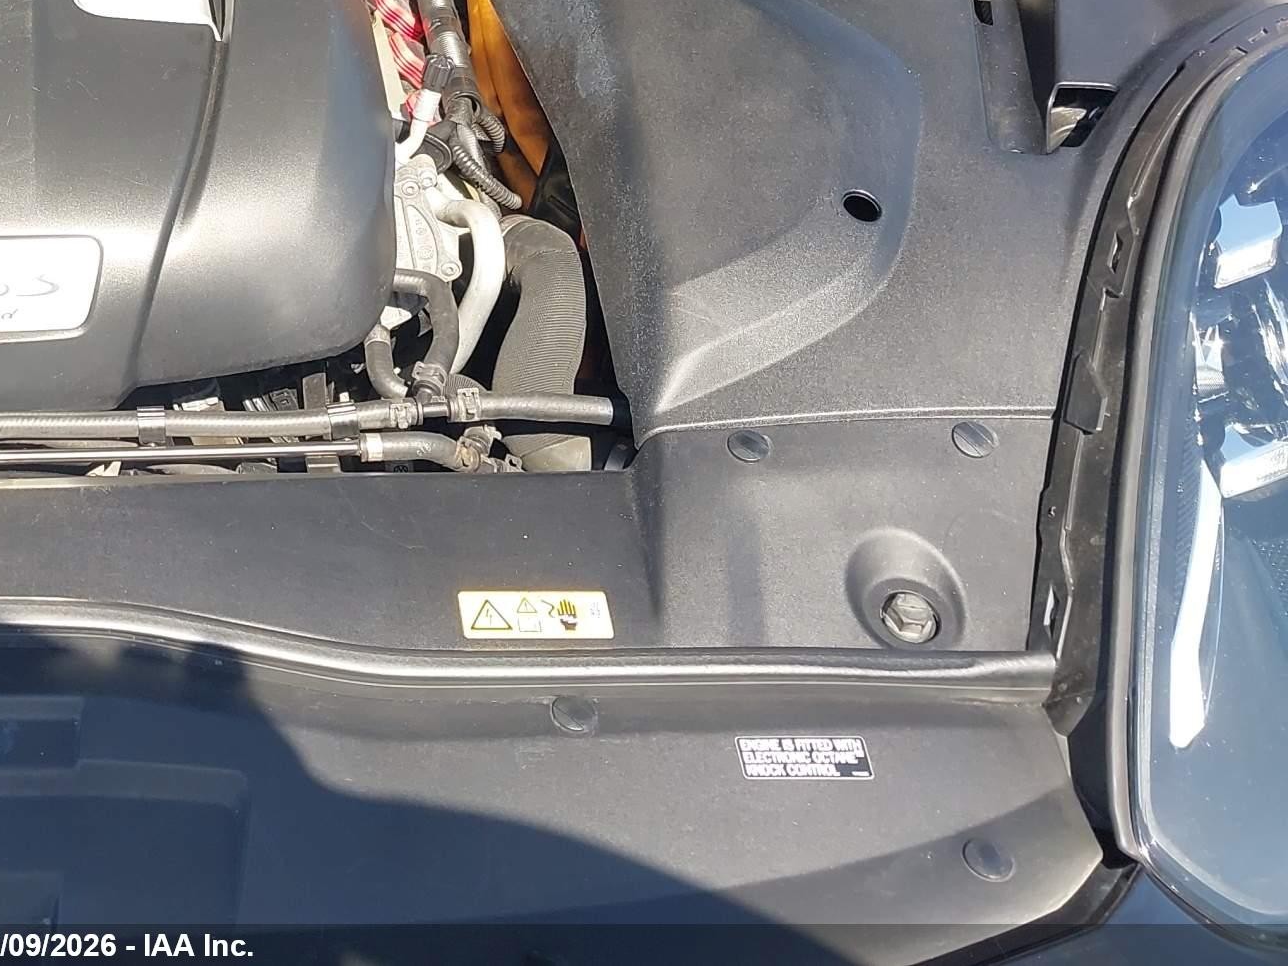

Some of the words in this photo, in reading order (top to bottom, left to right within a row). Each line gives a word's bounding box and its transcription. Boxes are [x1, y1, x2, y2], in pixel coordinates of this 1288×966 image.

[740, 739, 781, 752] ENGINE
[742, 752, 811, 764] ELECTRONIC
[745, 764, 786, 776] KNOCK
[786, 764, 840, 776] CONTROL
